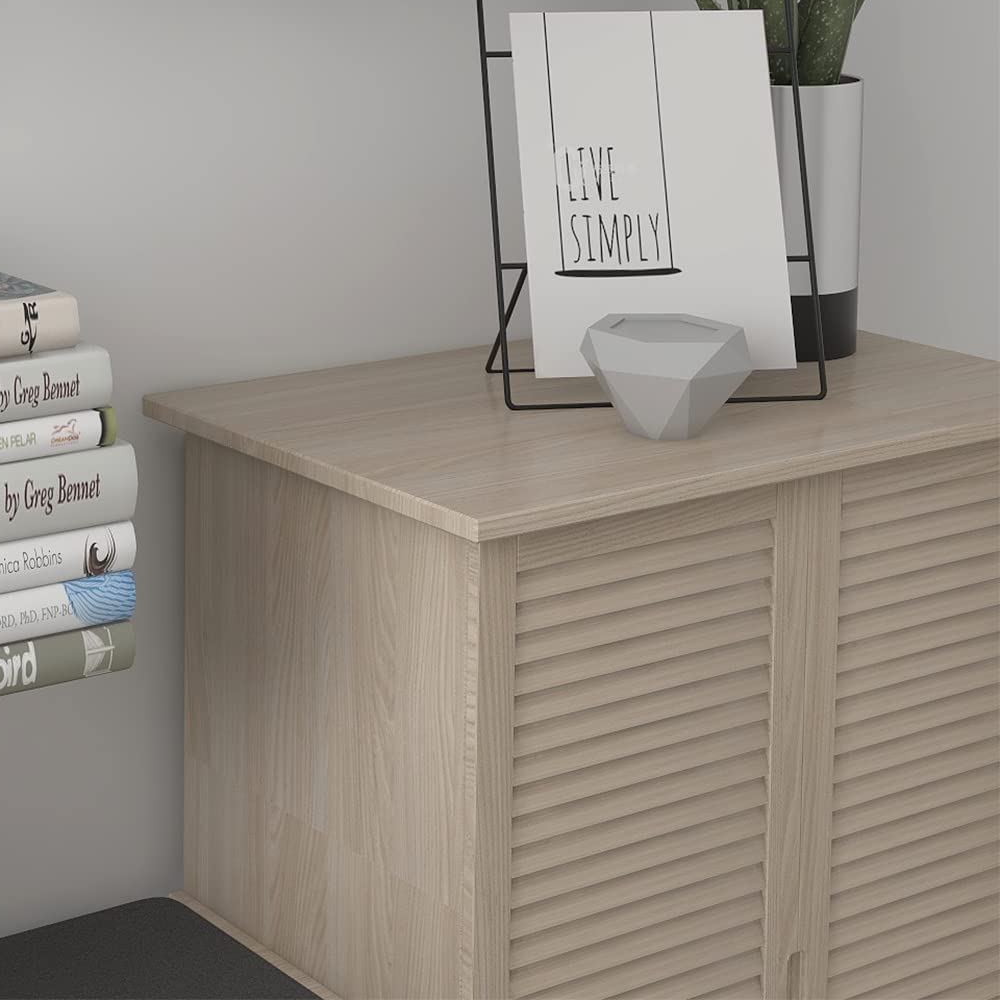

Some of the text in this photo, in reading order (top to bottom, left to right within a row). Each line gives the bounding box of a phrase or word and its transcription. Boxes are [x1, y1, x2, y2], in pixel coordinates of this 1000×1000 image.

[565, 146, 619, 201] LIVE
[570, 212, 660, 265] SIMPLY
[13, 374, 41, 408] Greg
[42, 371, 81, 402] Bennet
[10, 431, 38, 449] PELAR
[4, 473, 101, 521] by Greg Bennet
[22, 548, 63, 573] Robbins
[20, 610, 40, 626] PhD,
